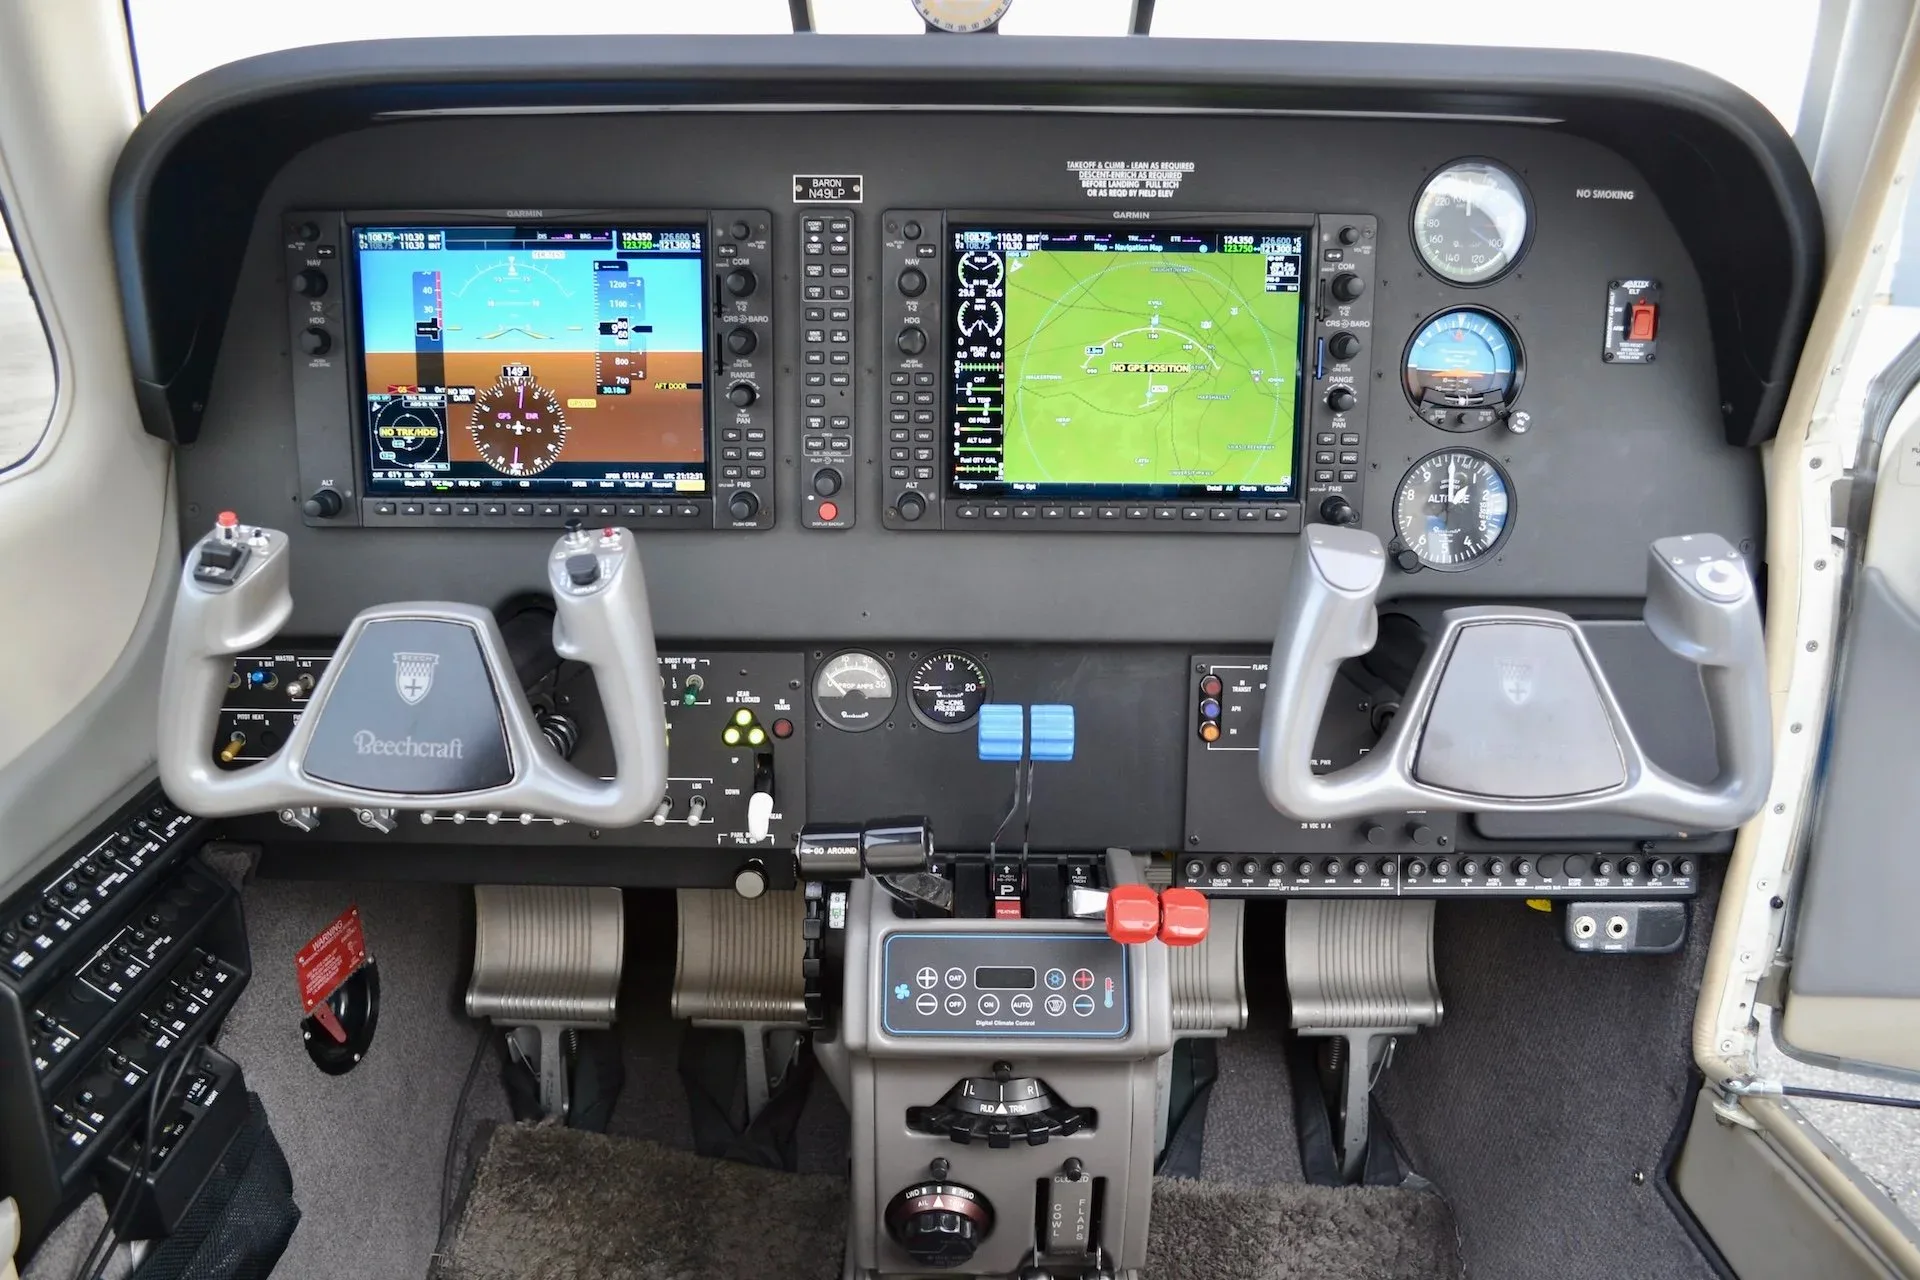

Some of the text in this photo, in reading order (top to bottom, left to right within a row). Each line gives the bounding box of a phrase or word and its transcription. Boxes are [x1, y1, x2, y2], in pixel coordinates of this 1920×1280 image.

[1131, 162, 1148, 170] LEAN
[1150, 162, 1159, 170] AS
[1161, 162, 1195, 170] REQUIRED
[812, 179, 842, 188] BARON
[809, 189, 846, 199] N49LP
[1087, 189, 1097, 197] OR
[1098, 189, 1107, 197] AS
[1129, 189, 1137, 197] BY
[1138, 189, 1156, 197] FIELD
[1158, 190, 1174, 198] ELEV
[1576, 189, 1634, 200] NO SMOKING
[1435, 197, 1450, 206] 220
[1426, 219, 1440, 227] 180
[368, 233, 393, 241] 108.75
[400, 233, 424, 241] 110.30
[622, 233, 690, 241] 124.350 126.600
[965, 233, 991, 241] 108.75
[997, 233, 1023, 241] 110.30
[1223, 236, 1291, 244] 124.350 126.600
[1429, 234, 1443, 243] 160
[997, 242, 1023, 250] 110.30
[1489, 239, 1502, 247] 100
[1114, 244, 1163, 252] Navigation Map
[1223, 244, 1291, 253] 123.750 121.300
[732, 258, 750, 266] COM
[904, 258, 920, 266] NAV
[1445, 254, 1460, 262] 140
[1471, 255, 1485, 263] 120
[609, 281, 627, 289] 1200
[422, 286, 433, 294] 40
[958, 289, 975, 297] 29.6
[986, 289, 1003, 297] 29.6
[424, 306, 434, 314] 30
[1326, 320, 1340, 328] CRS
[615, 358, 629, 366] 800
[1112, 364, 1189, 373] NO GPS POSITION
[654, 382, 687, 390] AFT DOOR
[498, 412, 511, 420] GPS
[380, 427, 437, 436] NO TRK/HDG
[1423, 472, 1431, 482] 9
[1407, 490, 1415, 501] 8
[1428, 494, 1470, 503] ALTIE
[1482, 490, 1489, 500] 2
[1405, 516, 1413, 528] 7
[1479, 520, 1486, 531] 3
[1418, 534, 1427, 545] 6
[1464, 536, 1472, 546] 4
[1441, 543, 1449, 553] 5
[945, 662, 954, 671] 10
[965, 683, 976, 692] 20
[353, 730, 464, 759] Beechcraft
[813, 846, 857, 855] GO AROUND
[1001, 885, 1014, 895] P
[312, 919, 344, 951] WARNING
[970, 1085, 975, 1095] L
[1028, 1086, 1034, 1095] R
[980, 1104, 1027, 1113] RUD TRIM
[906, 1189, 919, 1199] LWD
[1052, 1204, 1062, 1236] COWL
[1076, 1199, 1086, 1240] FLAPS
